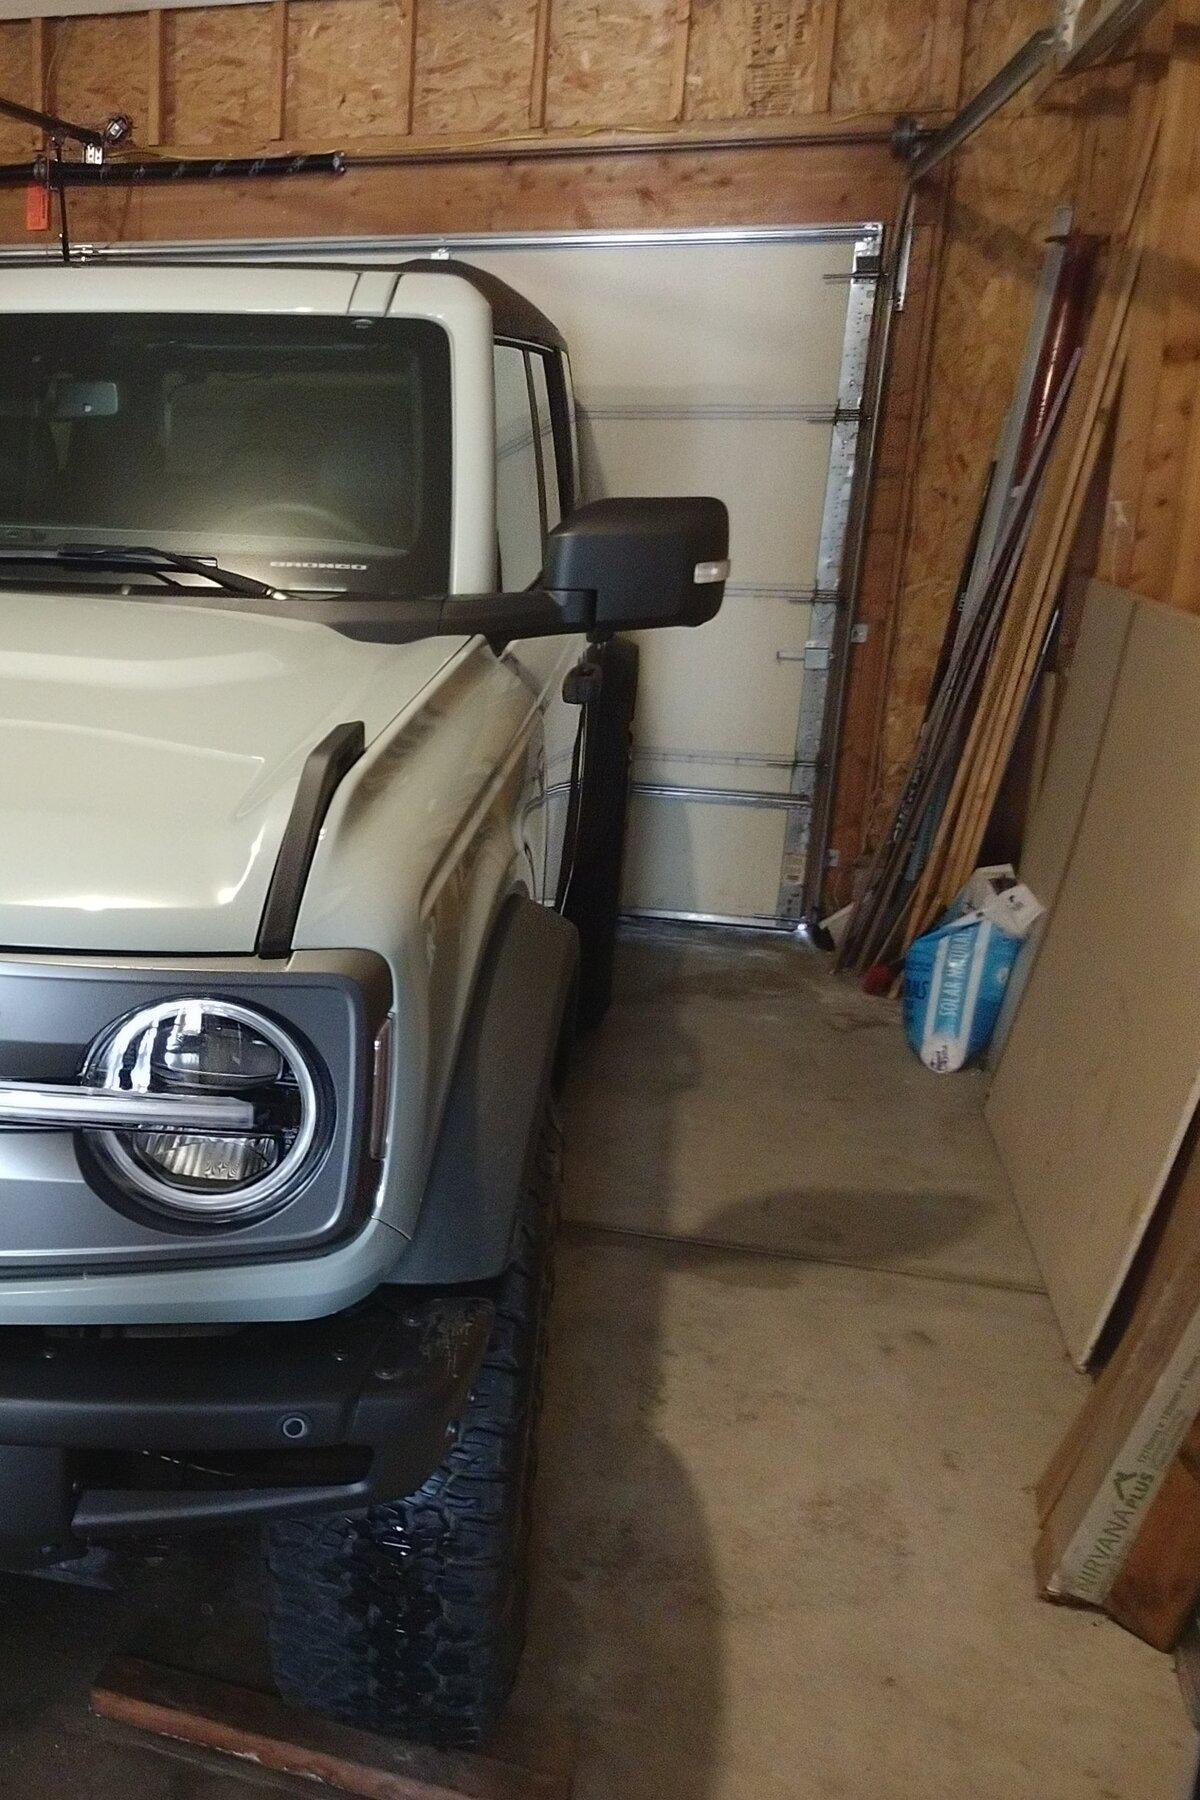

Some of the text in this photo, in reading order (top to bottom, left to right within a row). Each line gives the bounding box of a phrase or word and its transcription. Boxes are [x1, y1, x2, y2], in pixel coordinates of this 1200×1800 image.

[270, 561, 367, 570] BRONCO
[938, 981, 963, 1017] SOLAR
[1125, 1472, 1155, 1511] PLUS
[1077, 1509, 1135, 1595] NIRVANA
